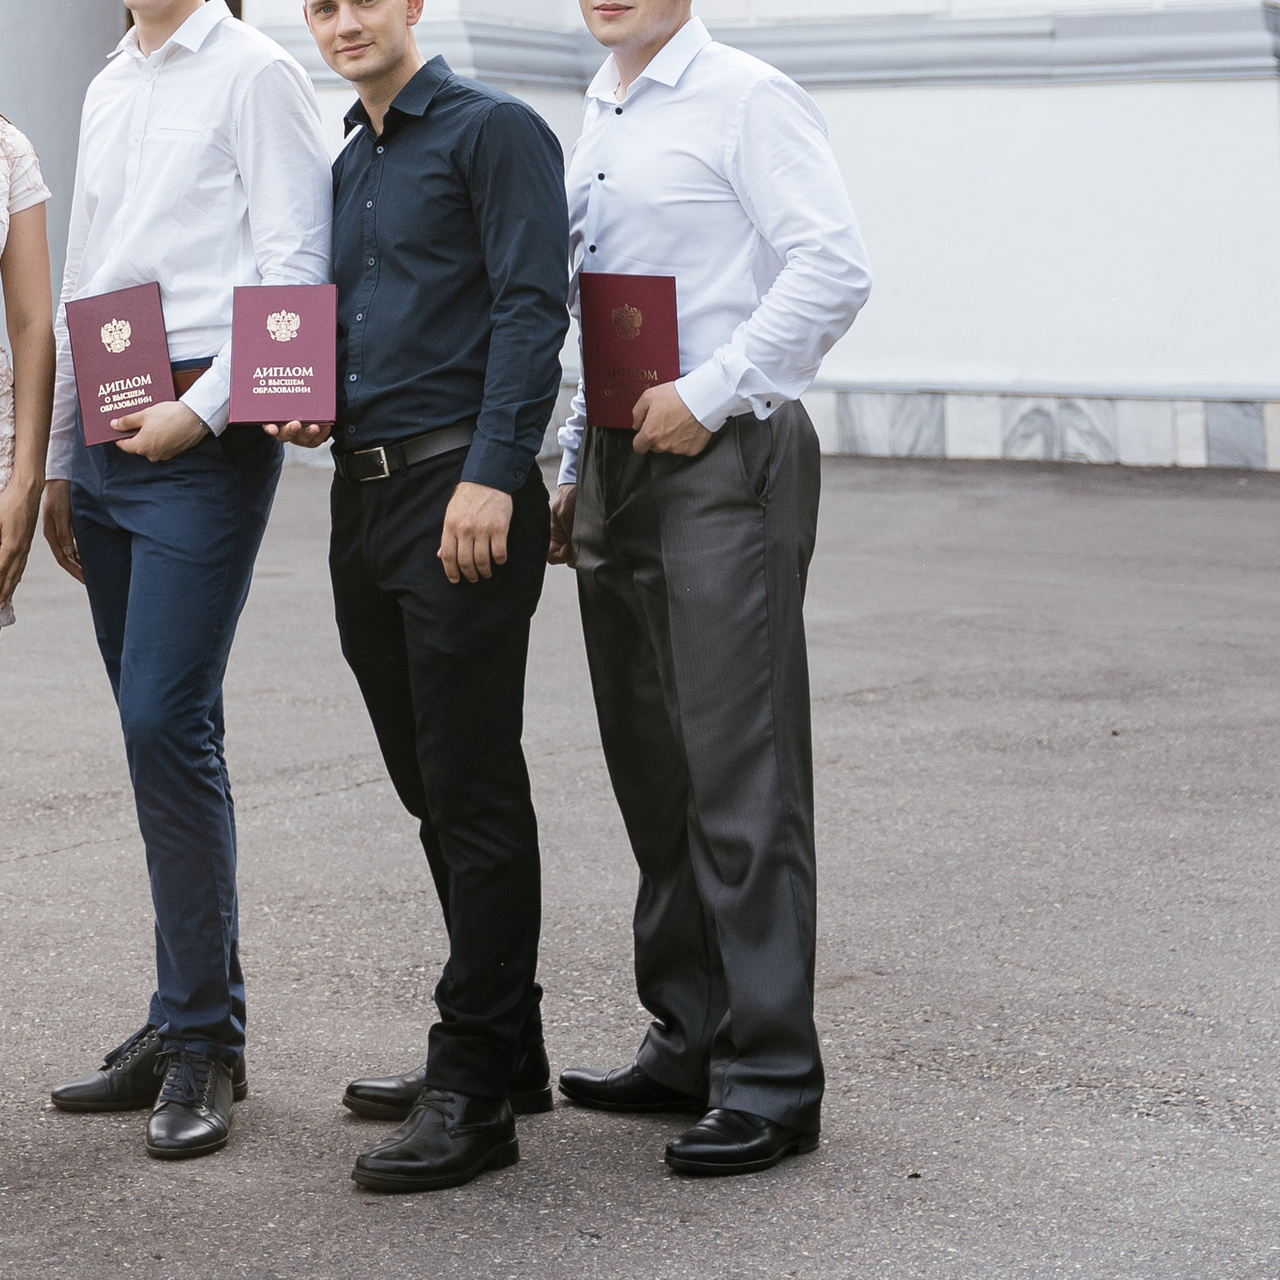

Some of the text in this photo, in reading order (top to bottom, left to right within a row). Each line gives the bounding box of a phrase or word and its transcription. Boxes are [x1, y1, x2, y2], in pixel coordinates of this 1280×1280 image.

[253, 366, 314, 379] ДИПЛОМ
[97, 373, 152, 398] ДИПЛОМ
[259, 378, 304, 387] О ВЫСШЕМ
[104, 388, 146, 404] О ВЫСШЕМ
[252, 386, 311, 394] ОБРАЗОВАНИИ
[100, 395, 152, 413] ОБРАЗОВАНИИ
